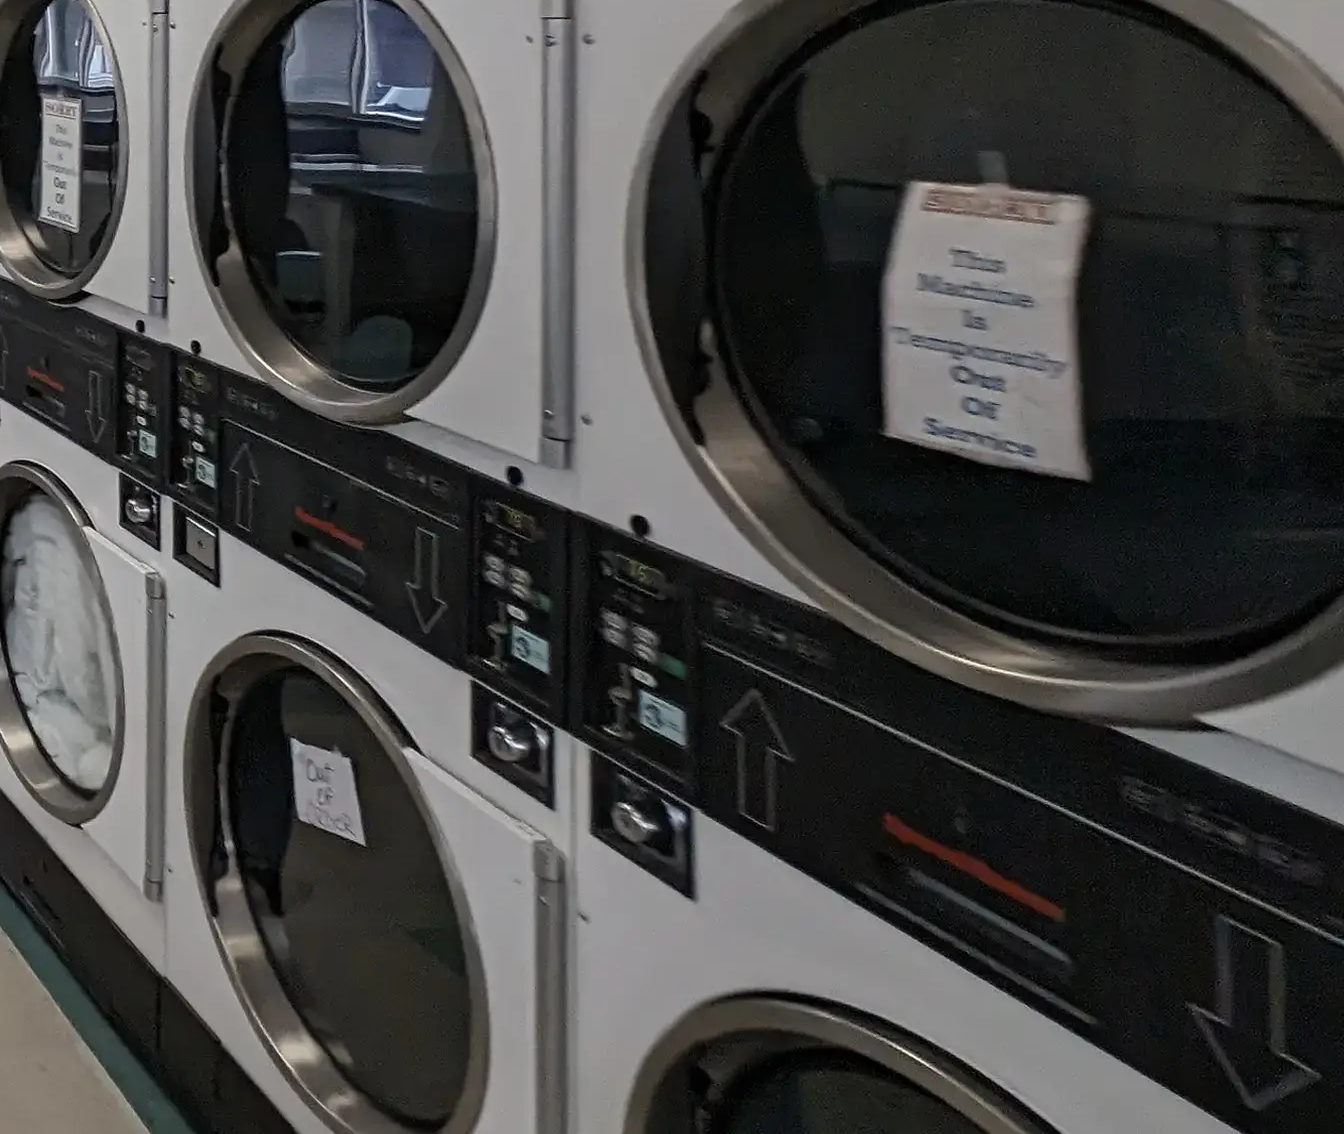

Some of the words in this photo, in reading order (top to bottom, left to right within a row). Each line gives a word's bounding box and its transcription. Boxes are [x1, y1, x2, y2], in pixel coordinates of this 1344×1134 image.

[916, 273, 1035, 308] Machine
[949, 366, 1007, 392] Out
[962, 396, 1000, 420] Of
[923, 416, 1037, 458] Service
